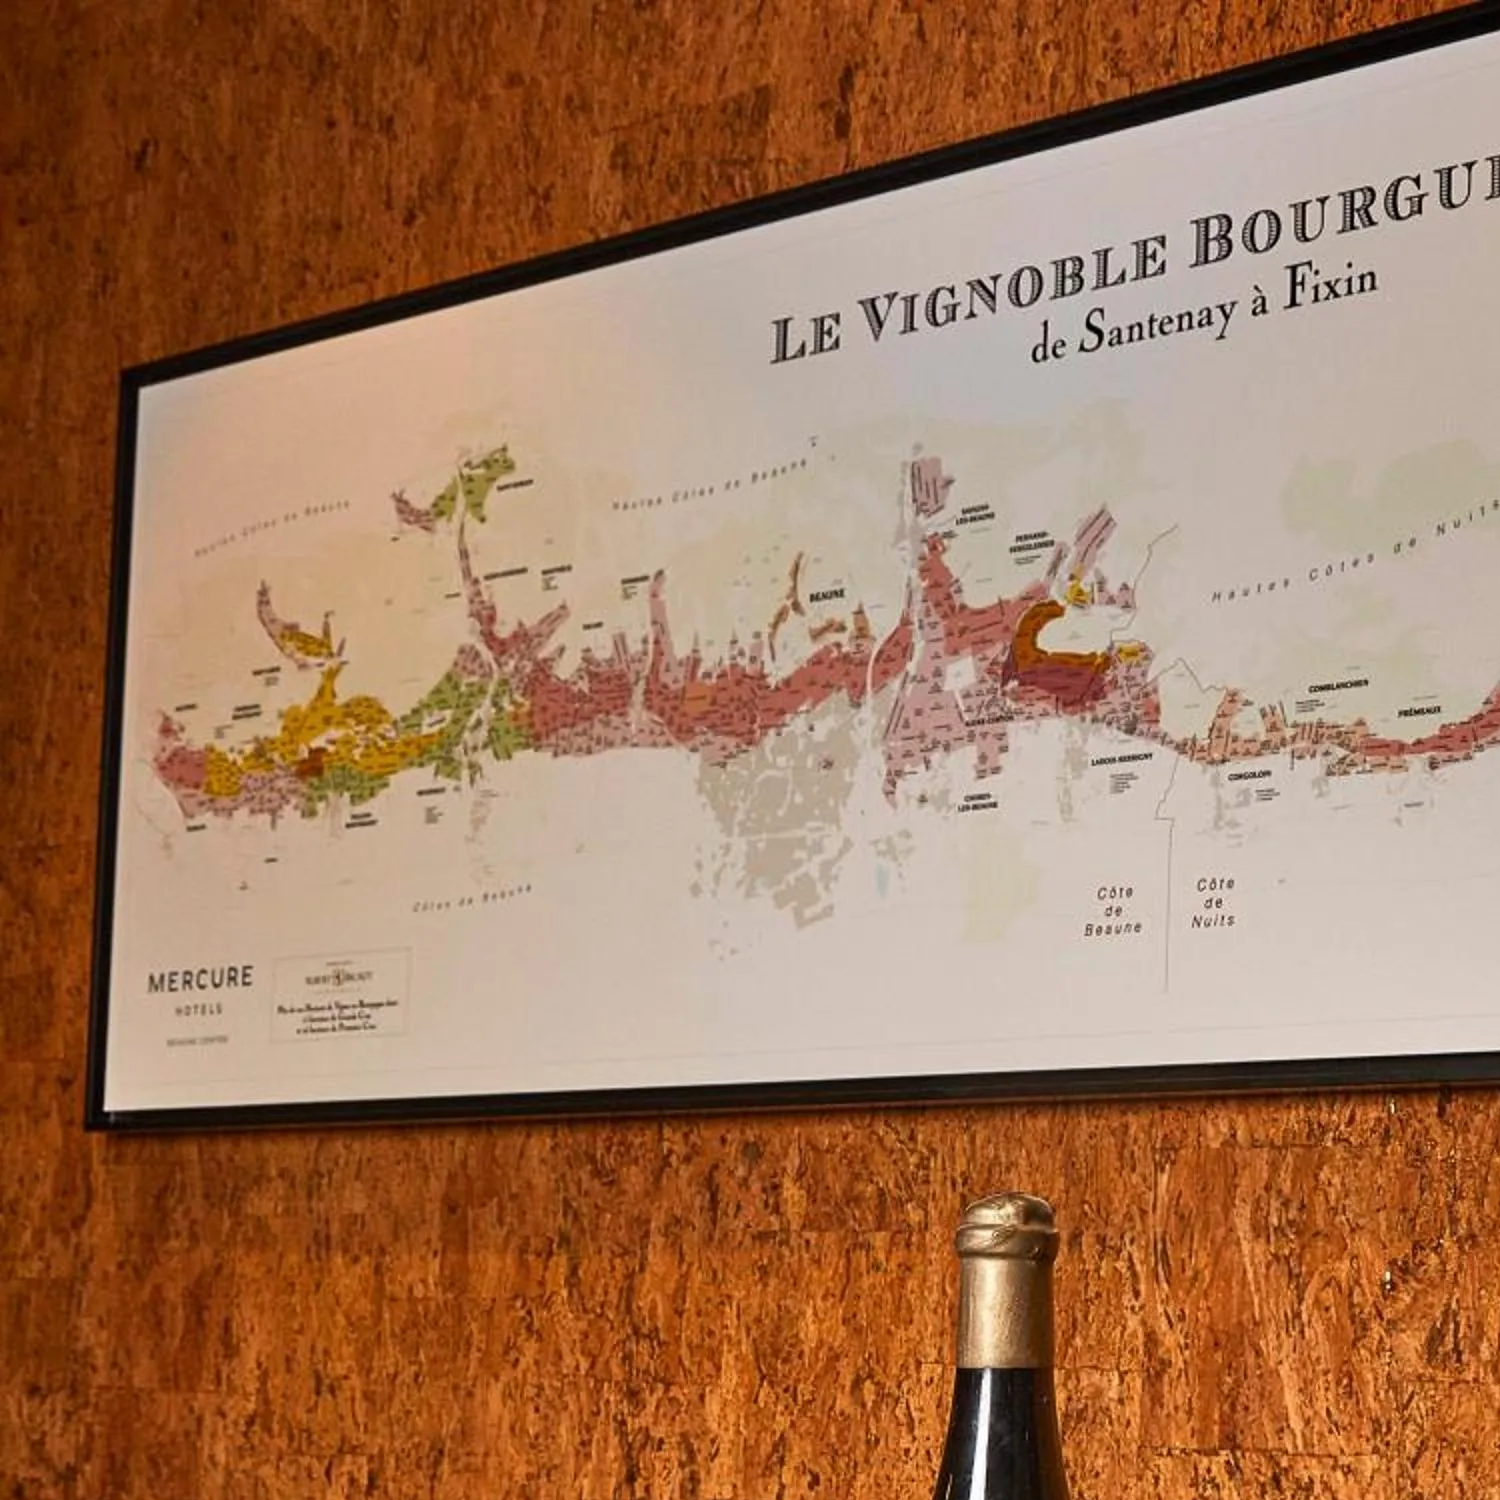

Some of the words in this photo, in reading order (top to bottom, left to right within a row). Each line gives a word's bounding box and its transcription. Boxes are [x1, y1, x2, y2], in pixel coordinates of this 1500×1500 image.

[769, 313, 841, 364] LE
[858, 234, 1168, 343] VIGNOBLE
[1030, 319, 1066, 365] de
[1077, 300, 1238, 354] Santenay
[1251, 285, 1269, 318] à
[1282, 261, 1379, 313] Fixin
[1196, 877, 1236, 893] Côte
[1096, 886, 1135, 901] Côte
[1104, 905, 1123, 917] de
[1203, 897, 1224, 909] de
[1083, 920, 1143, 938] Beaune
[1191, 914, 1236, 929] Nuits
[147, 964, 255, 993] MERCURE
